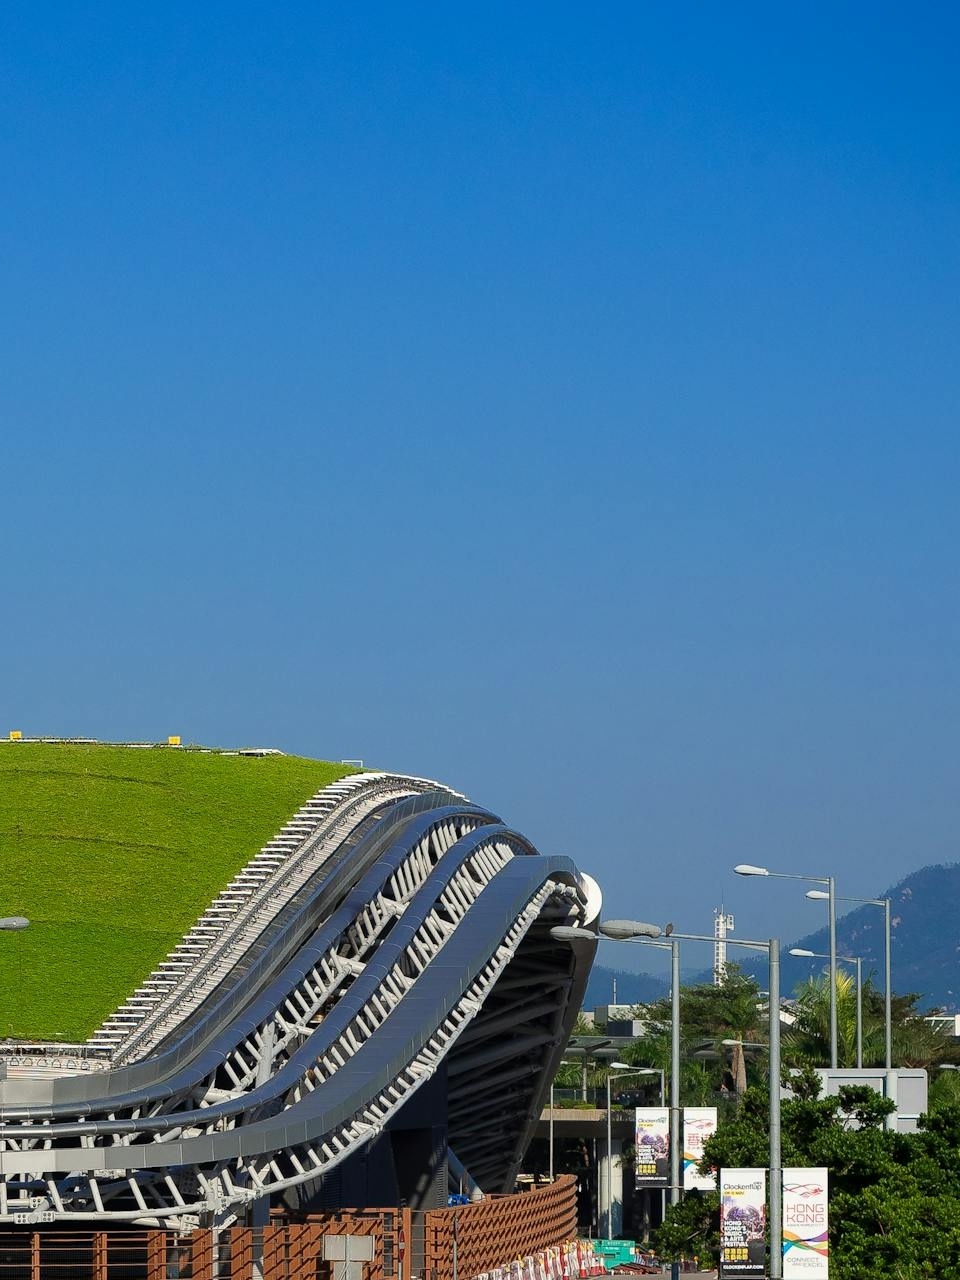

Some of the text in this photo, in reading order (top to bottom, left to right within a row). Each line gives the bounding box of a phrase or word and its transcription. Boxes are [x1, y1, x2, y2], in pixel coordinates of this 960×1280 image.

[723, 1183, 762, 1191] Clockenflap
[786, 1203, 824, 1213] HONG
[786, 1213, 824, 1223] KONG
